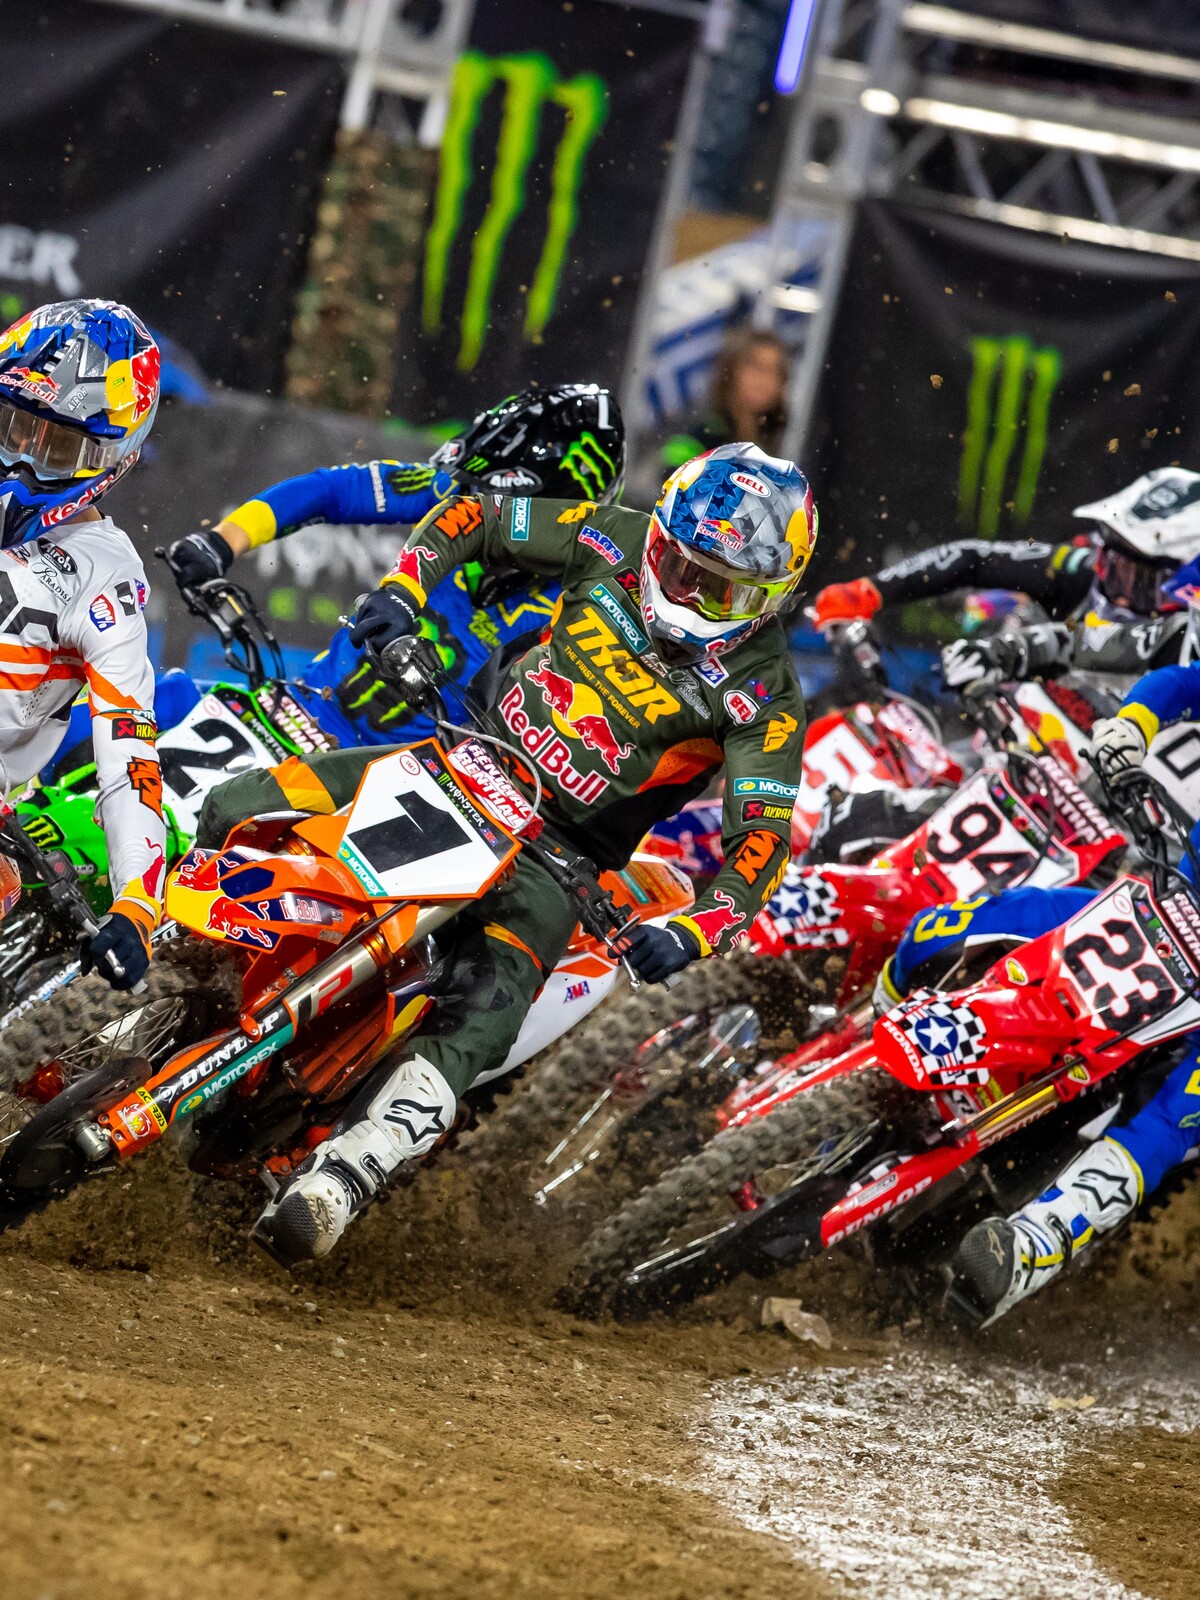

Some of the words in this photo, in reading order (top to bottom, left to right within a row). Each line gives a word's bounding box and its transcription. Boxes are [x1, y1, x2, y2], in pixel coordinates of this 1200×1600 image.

[26, 382, 57, 403] Bull
[68, 386, 89, 412] AIROH
[736, 475, 764, 494] BELL
[698, 525, 722, 540] Red
[718, 532, 743, 552] Bull
[91, 597, 115, 630] 100%
[599, 594, 643, 647] MOTOREX
[564, 645, 577, 662] THE
[575, 655, 597, 682] FIRST
[594, 677, 611, 698] THE
[607, 693, 642, 729] FOREVER
[565, 607, 682, 725] THOR
[499, 683, 552, 758] Red
[540, 743, 611, 807] Bull
[447, 781, 485, 829] MONSTER
[455, 749, 525, 827] RENTHAL
[469, 744, 533, 817] RENTHAL
[759, 780, 799, 798] MOTOR
[347, 790, 474, 875] 1
[926, 802, 1034, 898] 94
[347, 855, 383, 896] MOTOREX
[563, 980, 591, 1004] AMA
[1064, 918, 1178, 1033] 23
[203, 1042, 280, 1100] MOTOREX
[882, 1020, 926, 1084] HONDA
[137, 1088, 167, 1128] ACERBIS
[827, 1175, 933, 1248] DUNLOP
